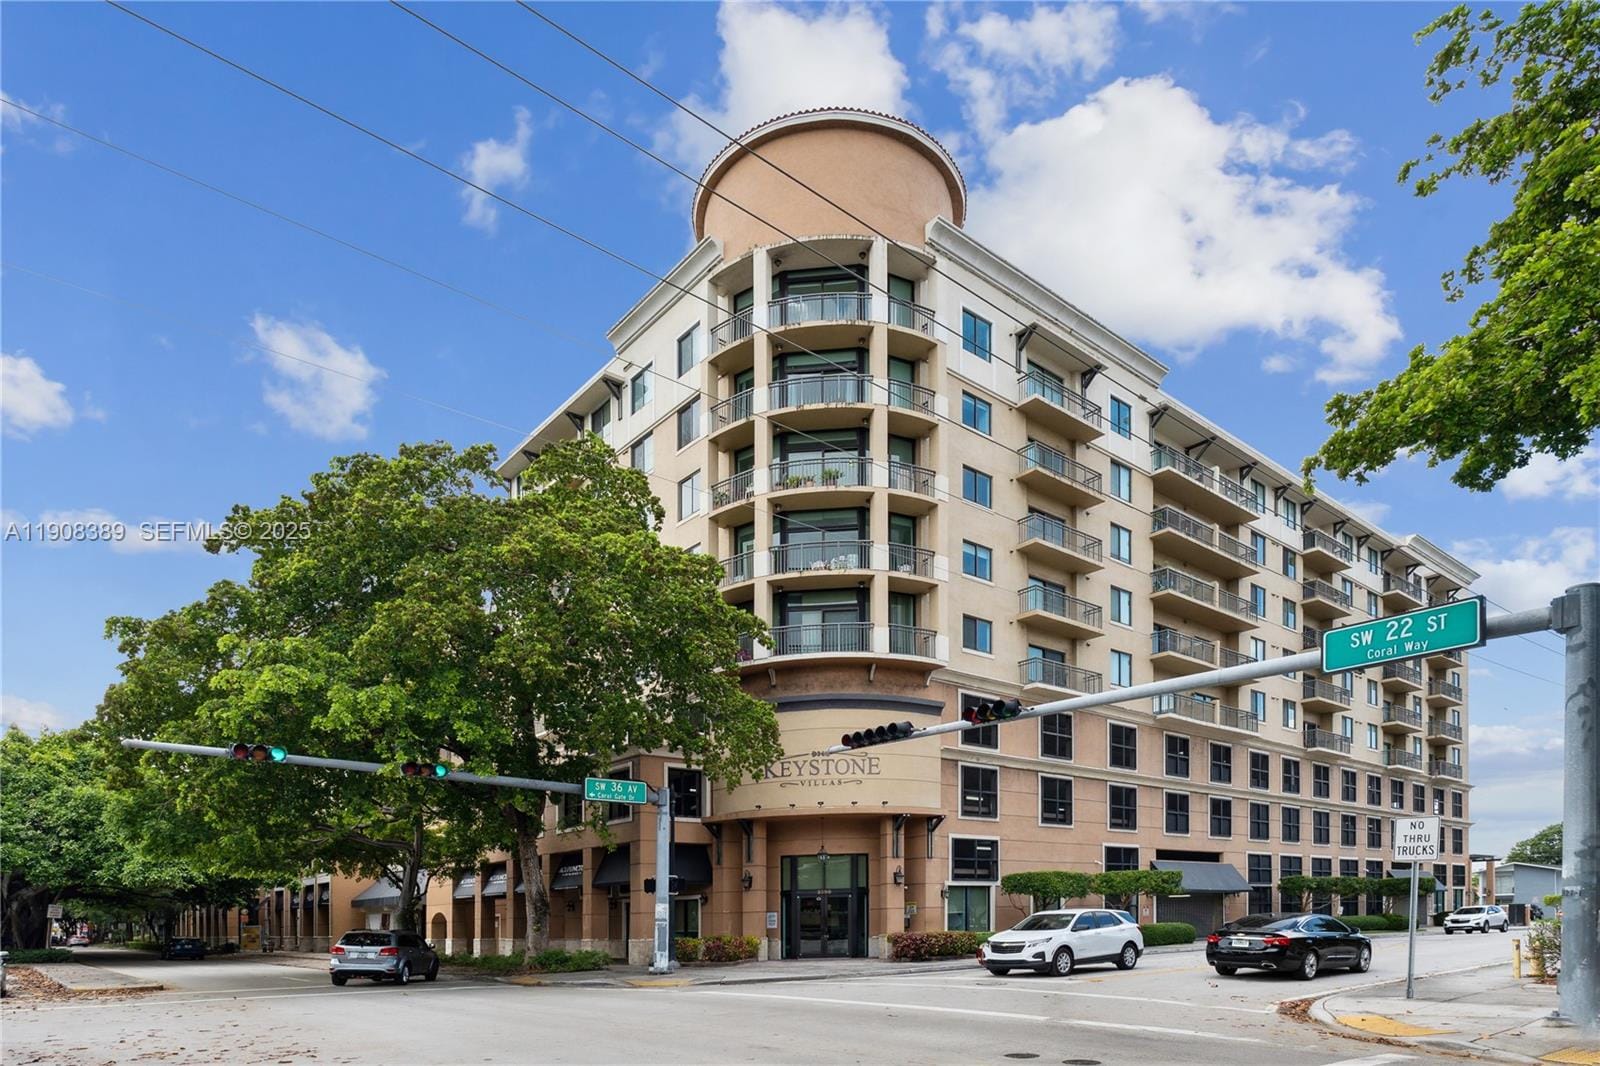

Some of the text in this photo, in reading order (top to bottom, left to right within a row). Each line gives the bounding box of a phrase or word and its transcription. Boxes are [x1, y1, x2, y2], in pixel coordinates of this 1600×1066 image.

[1350, 613, 1448, 648] SW 22 ST
[1367, 640, 1429, 660] Coral Way
[764, 757, 881, 779] KEYSTONE
[595, 782, 638, 793] SW 36 AV
[800, 779, 842, 787] VILLAS
[1410, 820, 1425, 830] NO
[1403, 833, 1431, 844] THRU
[1396, 844, 1435, 857] TRUCKS
